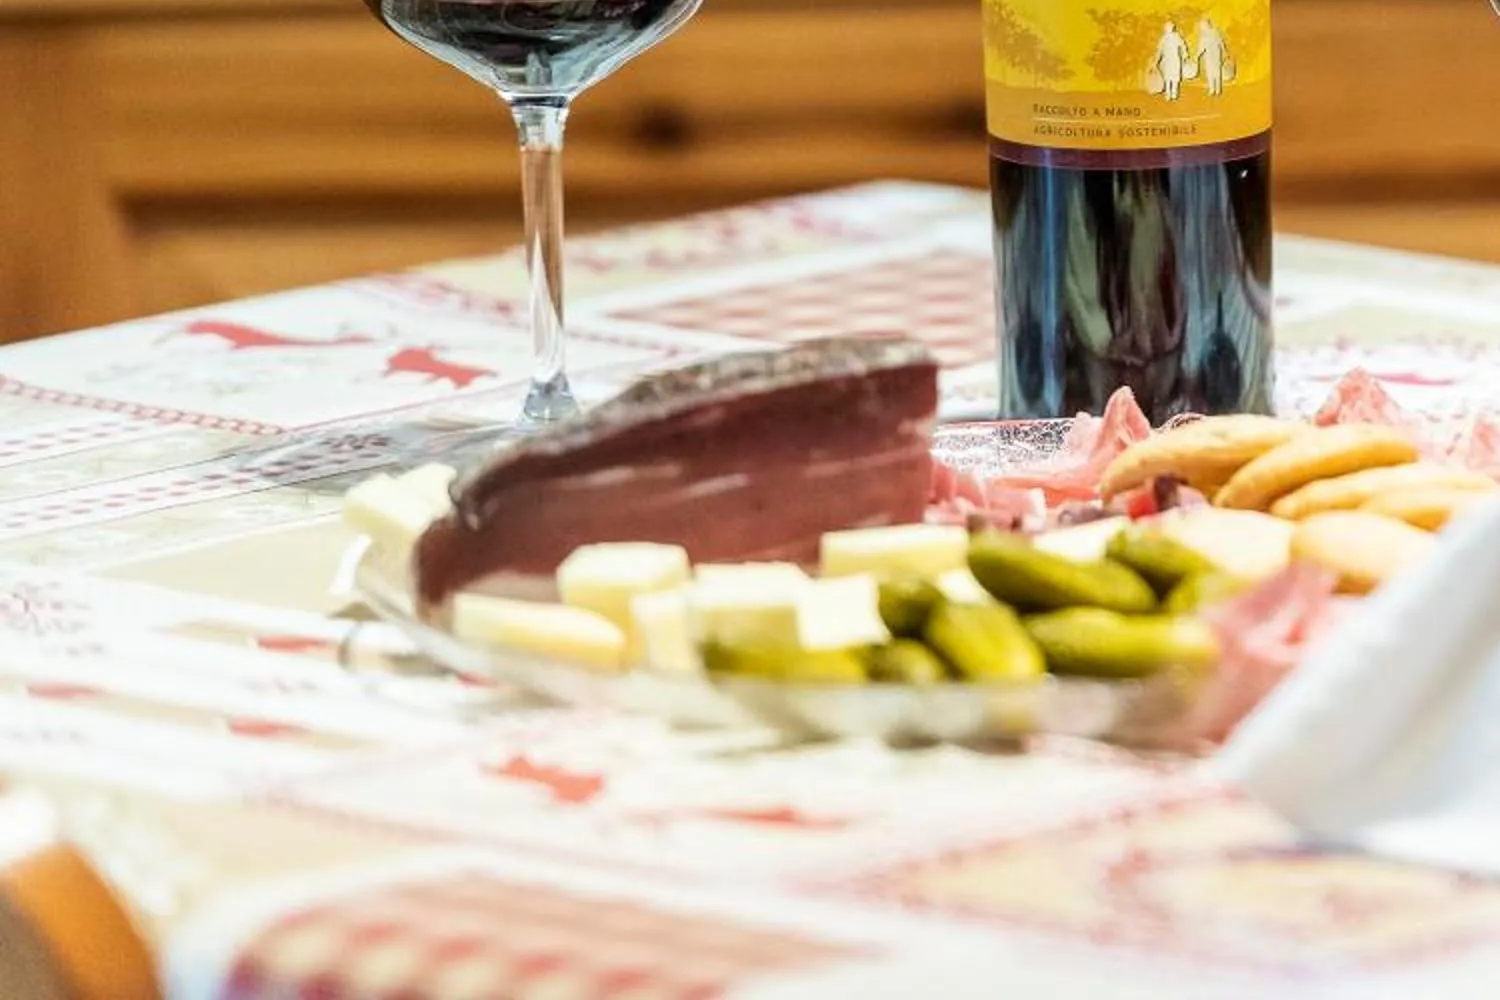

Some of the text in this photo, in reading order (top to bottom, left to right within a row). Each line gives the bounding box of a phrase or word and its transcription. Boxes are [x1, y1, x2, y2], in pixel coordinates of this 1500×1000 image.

[1093, 106, 1102, 117] A
[1104, 105, 1142, 117] MANO
[1118, 123, 1199, 139] SOSTENIBILE
